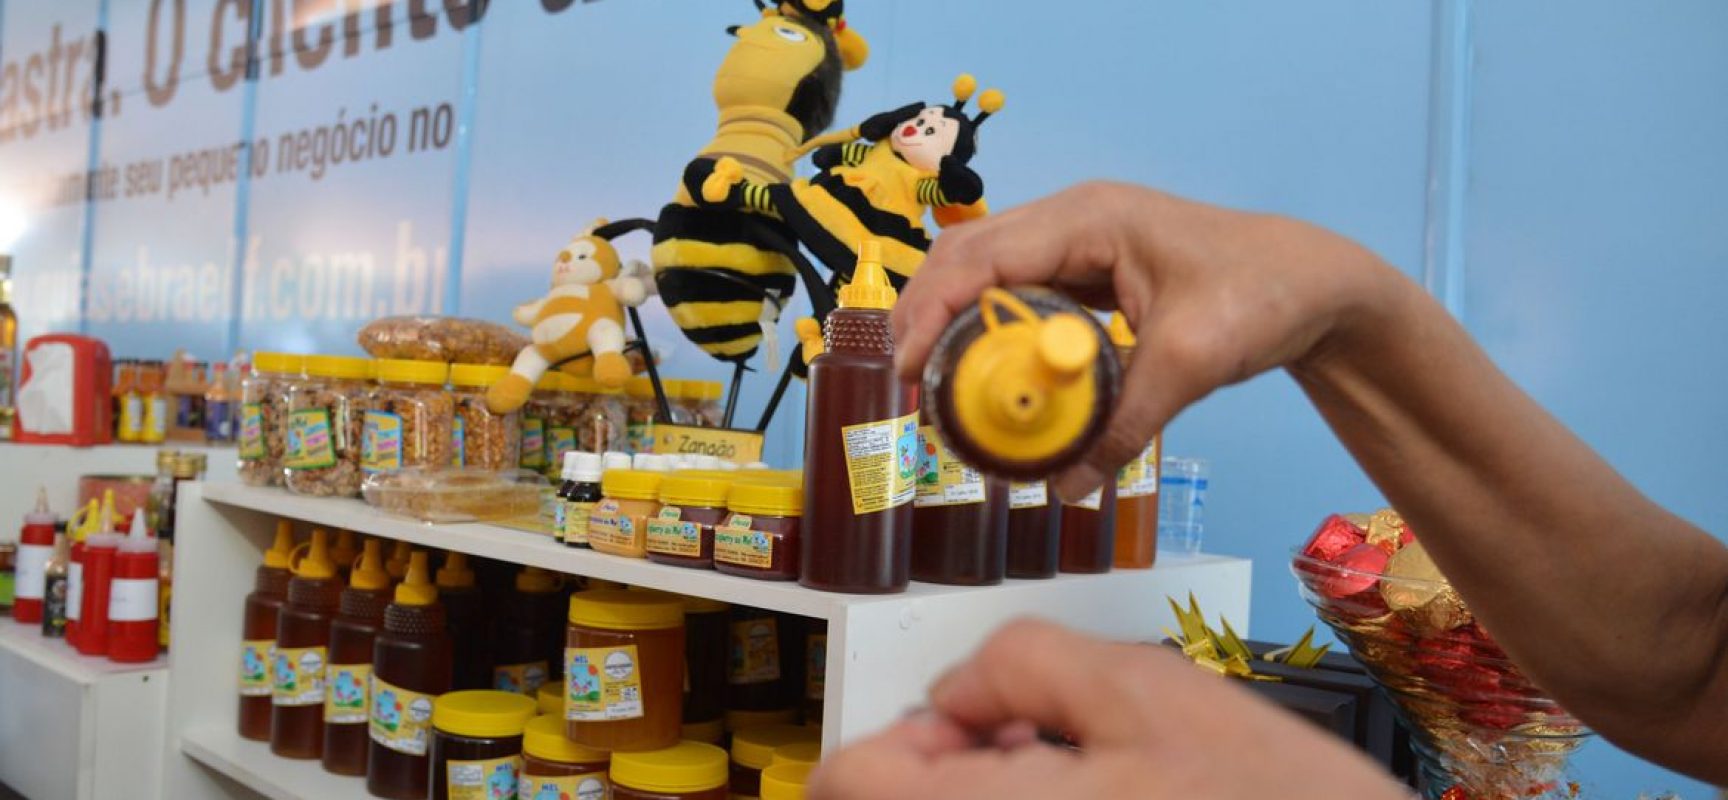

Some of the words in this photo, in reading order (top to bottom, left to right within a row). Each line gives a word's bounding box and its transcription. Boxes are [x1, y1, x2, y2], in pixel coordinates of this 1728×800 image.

[124, 157, 162, 198] seu
[277, 105, 397, 181] negócio
[407, 101, 454, 153] no
